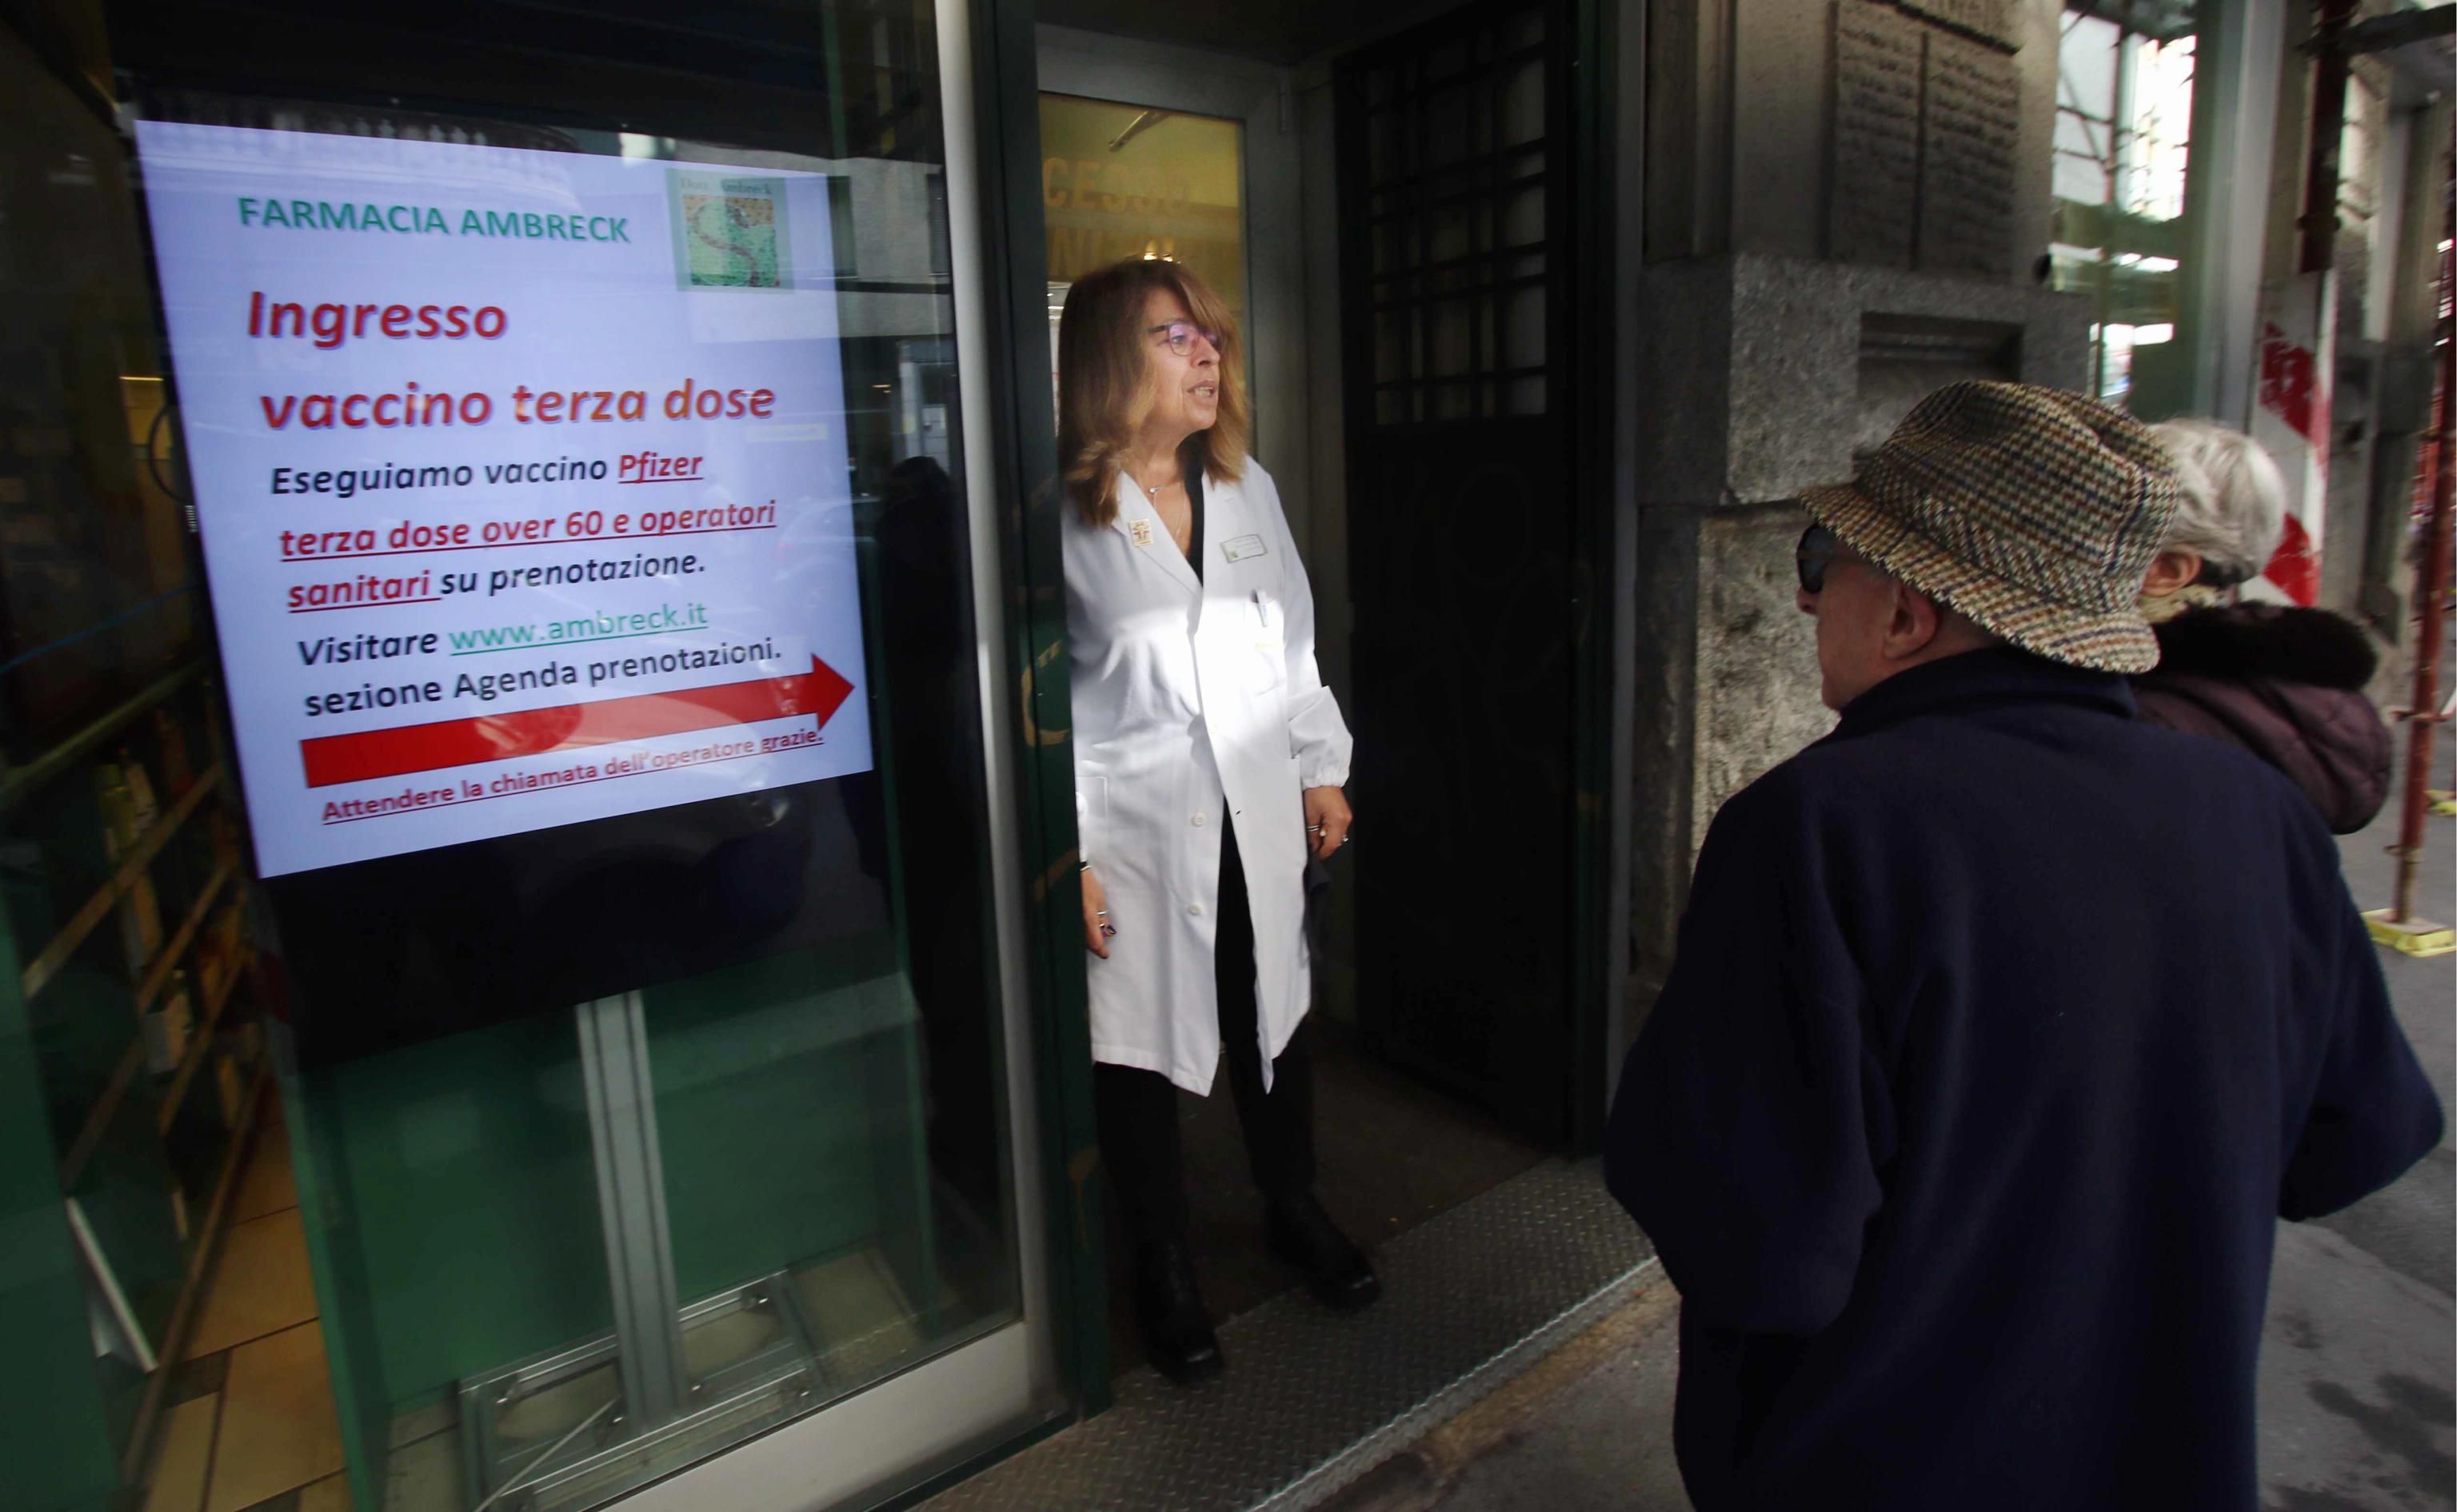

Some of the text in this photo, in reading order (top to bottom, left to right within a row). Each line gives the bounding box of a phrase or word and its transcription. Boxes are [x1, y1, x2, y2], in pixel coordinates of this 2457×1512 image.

[238, 197, 629, 243] FARMACIA AMBRECK
[247, 291, 507, 348] Ingresso
[261, 377, 775, 429] vaccino terza dose
[271, 452, 704, 497] Eseguiamo vaccino Pfizer
[281, 500, 778, 559] terza dose over 60 e operatori
[288, 553, 706, 610] sanitari su prenotazione.
[298, 602, 709, 666] Visitare www.ambreck.it
[305, 637, 783, 717] sezione Agenda prenotazioni.
[322, 729, 825, 821] Attendere la chiamata dell'operatore grazie.
